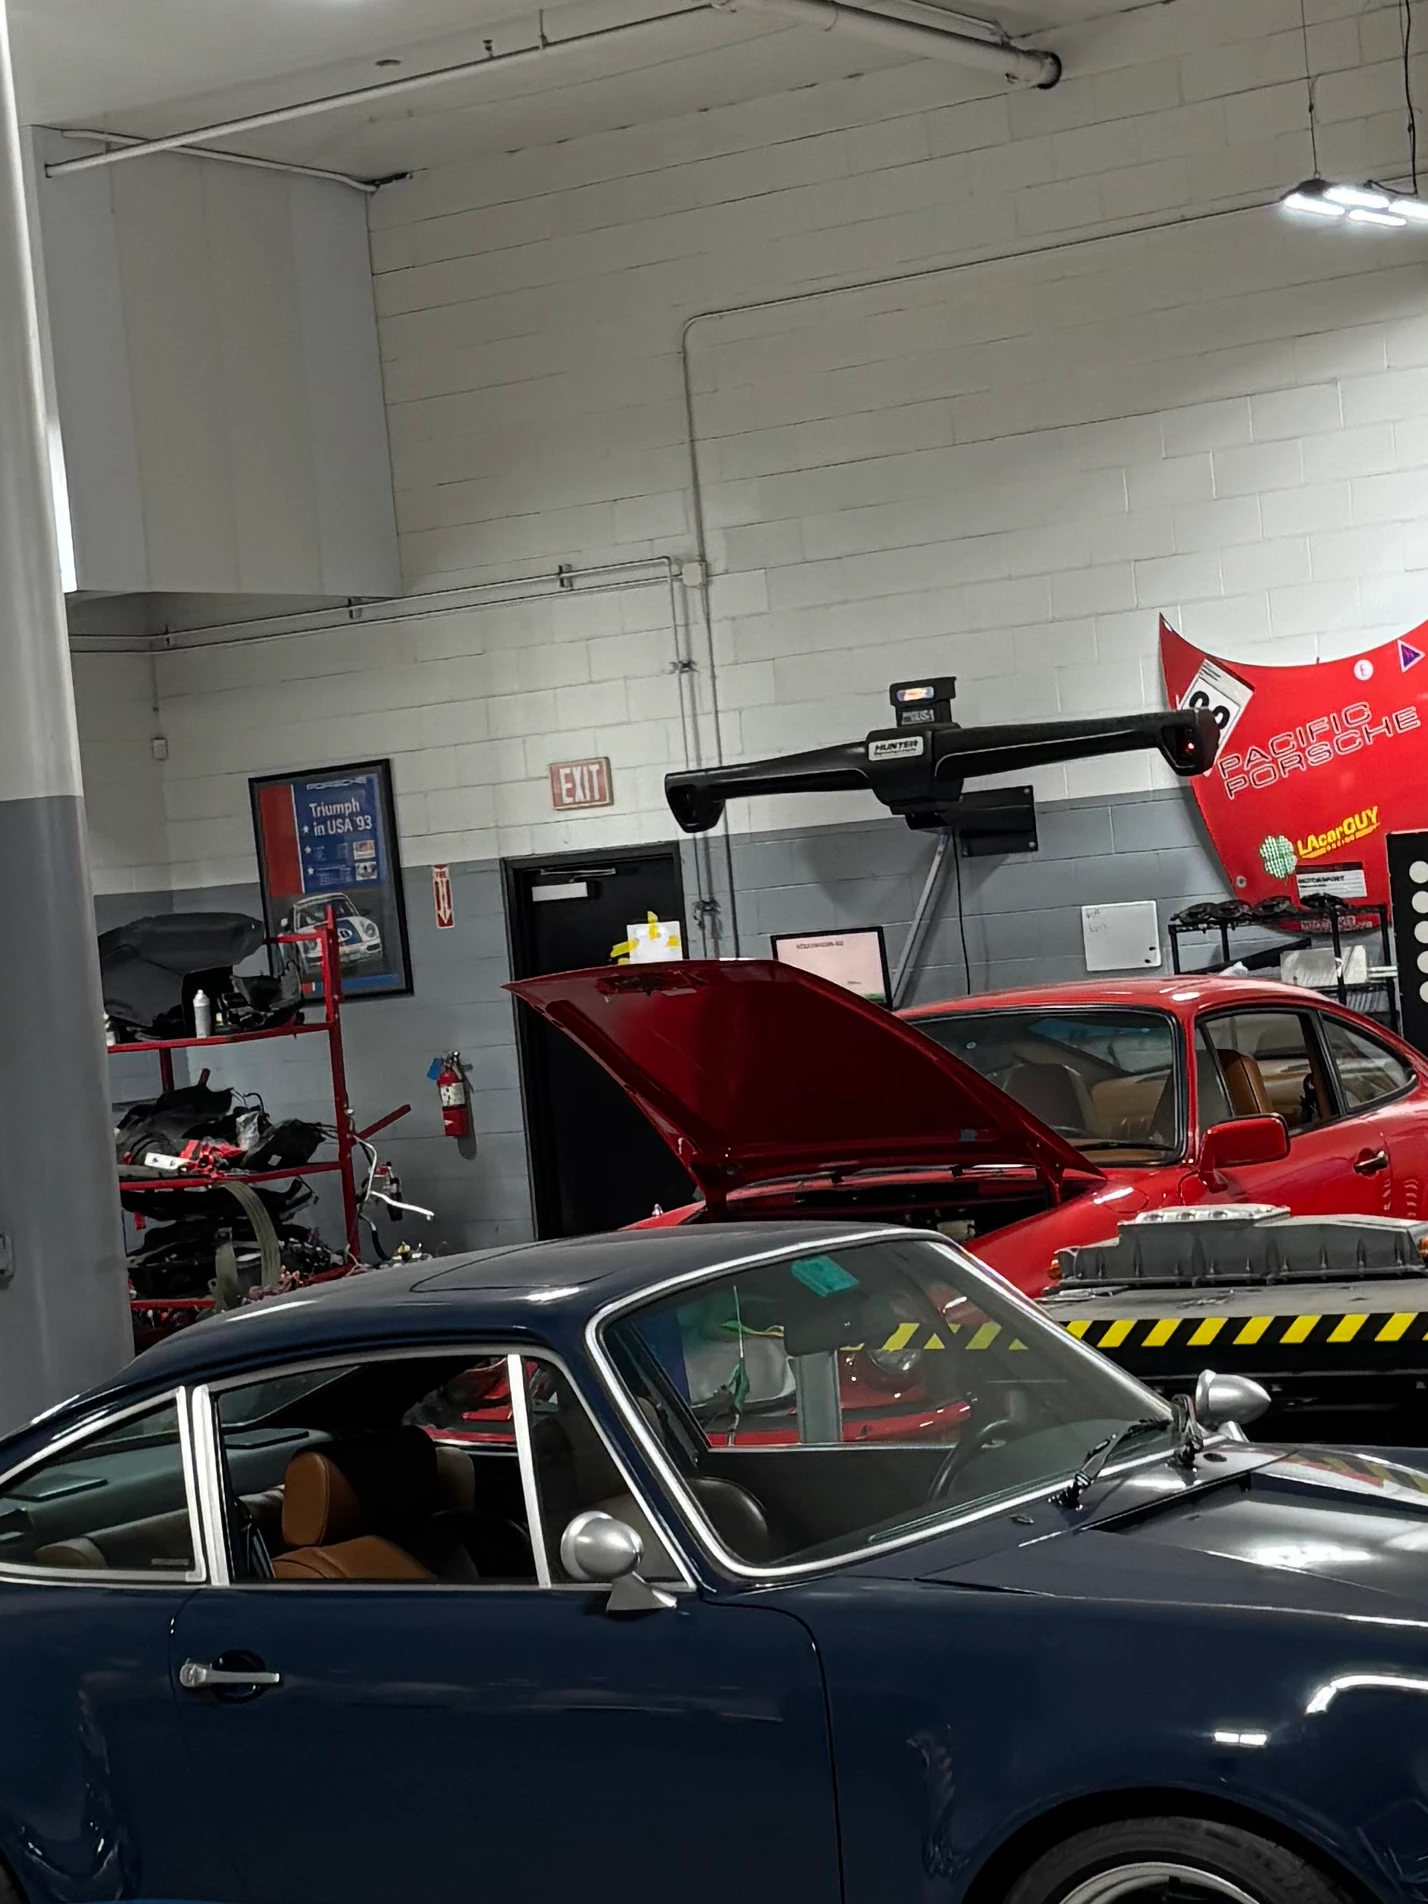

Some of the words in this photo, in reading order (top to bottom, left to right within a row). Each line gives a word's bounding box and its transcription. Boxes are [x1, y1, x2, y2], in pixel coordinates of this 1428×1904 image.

[1219, 701, 1371, 779] PACIFIC
[1225, 706, 1421, 800] PORSCHE
[558, 764, 600, 805] EXIT
[309, 798, 360, 818] Triumph
[313, 821, 325, 836] in
[327, 817, 353, 835] USA
[354, 815, 373, 831] '93
[1297, 805, 1379, 856] LAcarGUY
